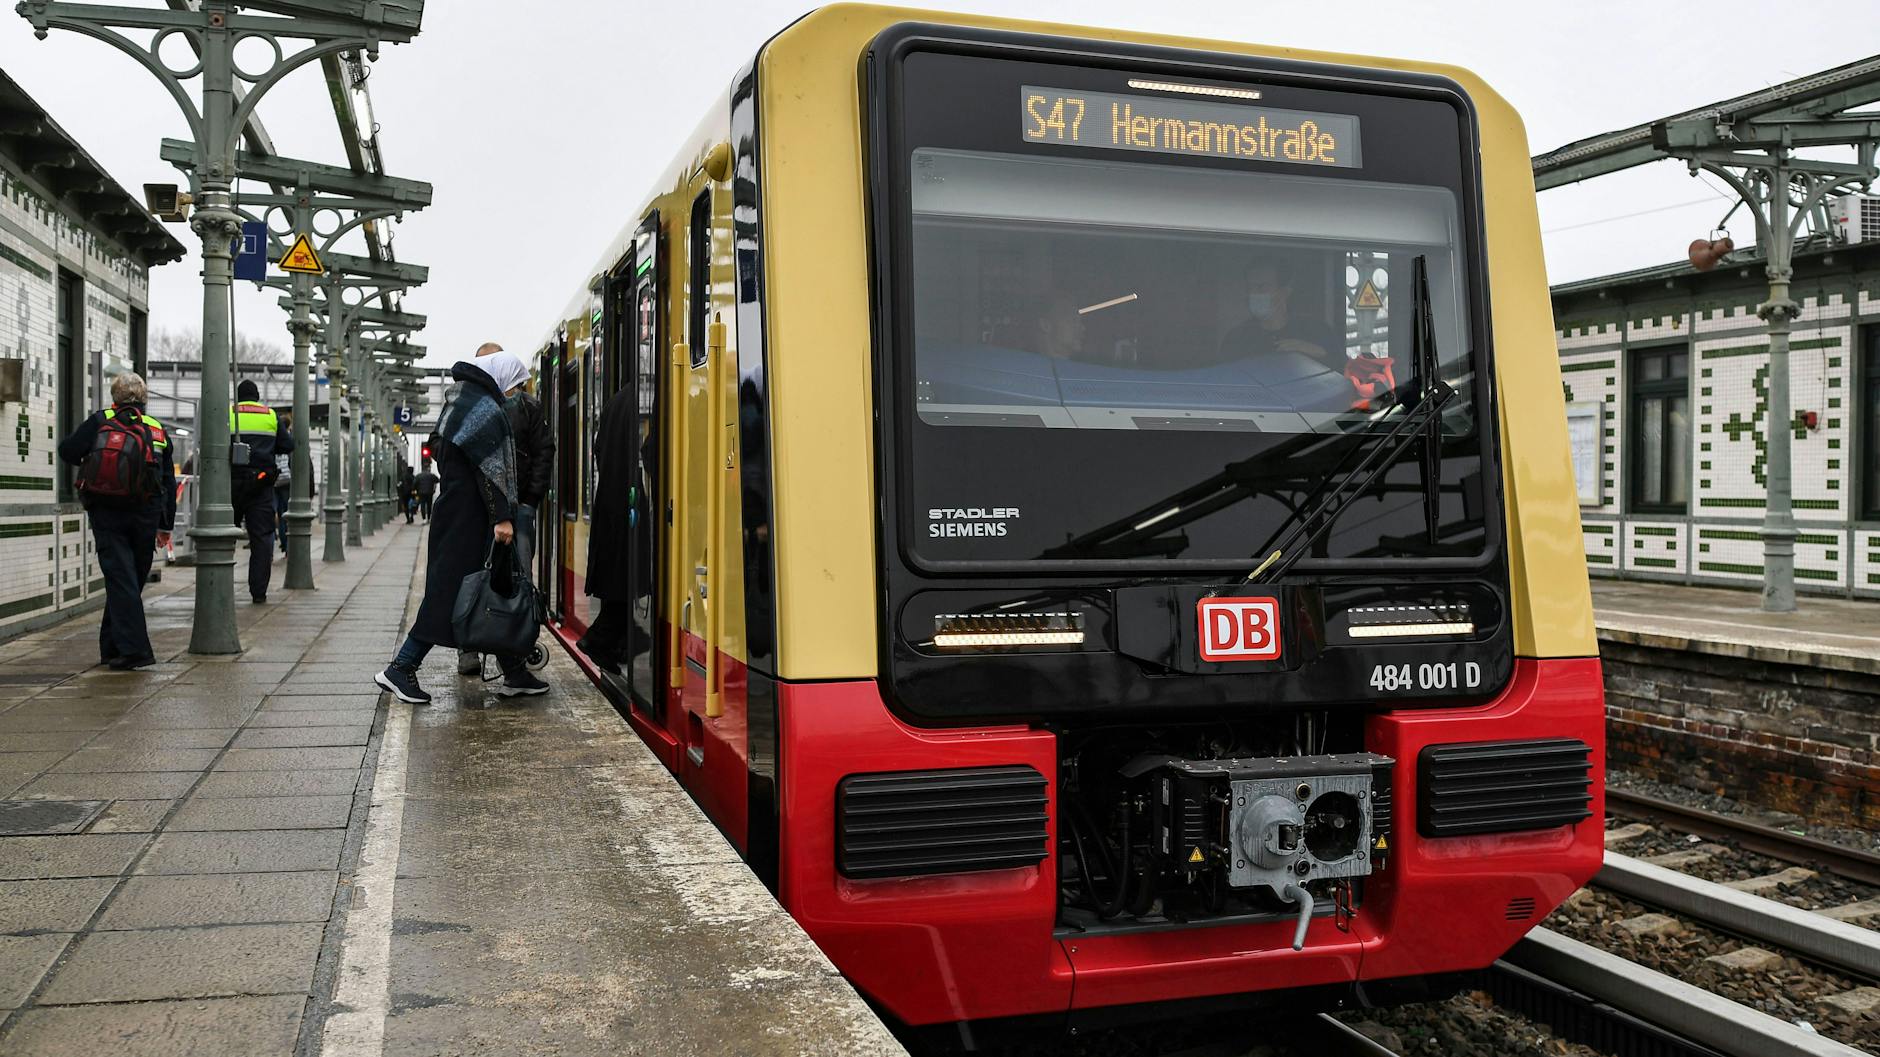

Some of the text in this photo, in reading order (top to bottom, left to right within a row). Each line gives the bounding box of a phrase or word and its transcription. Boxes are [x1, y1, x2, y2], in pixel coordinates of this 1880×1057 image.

[1027, 95, 1336, 163] S47 Hermannstraße
[400, 407, 411, 422] 5
[928, 507, 1020, 520] STADLER
[928, 522, 1008, 538] SIEMENS
[1209, 608, 1271, 650] DB
[1369, 661, 1481, 691] 484 001 D
